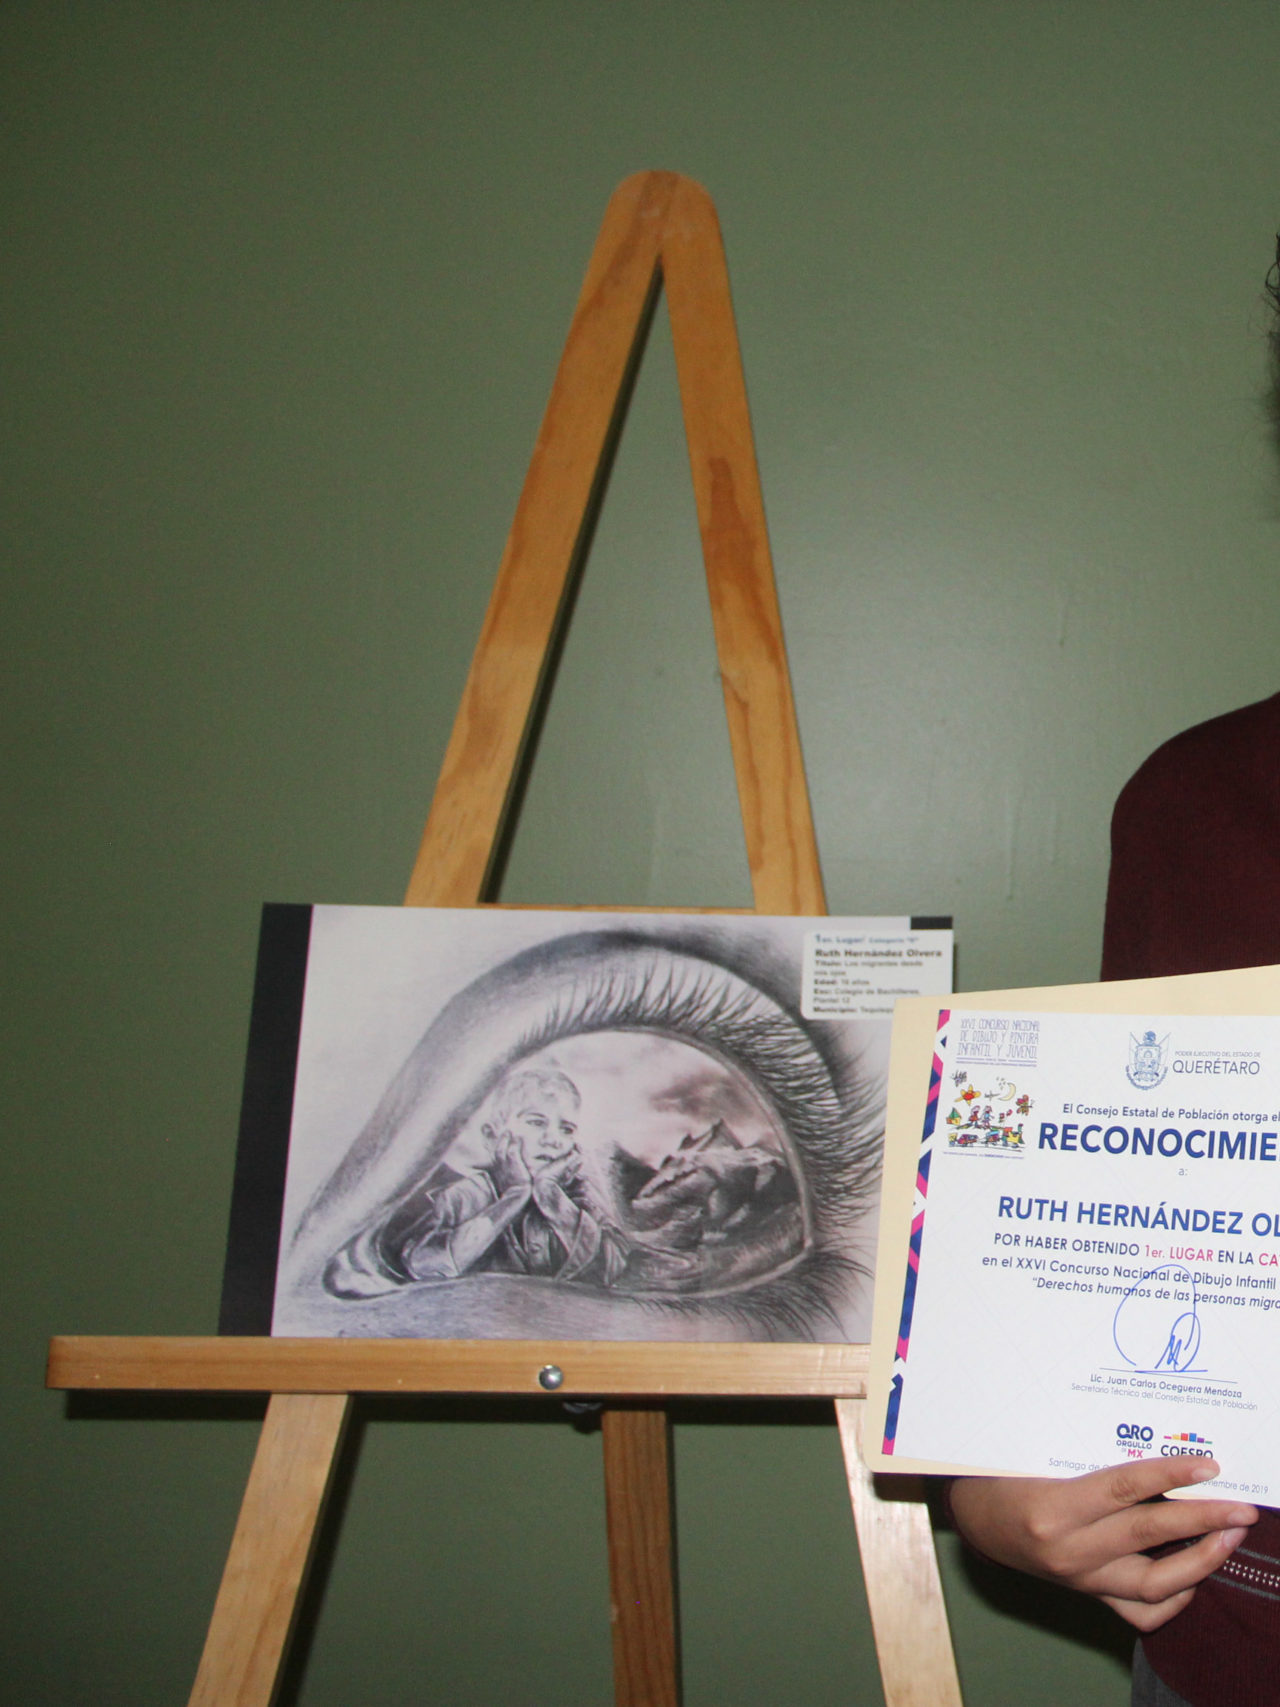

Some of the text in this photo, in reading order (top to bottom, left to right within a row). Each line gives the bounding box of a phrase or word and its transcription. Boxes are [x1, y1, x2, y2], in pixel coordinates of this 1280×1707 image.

[815, 949, 942, 957] Ruth Hernández Olvera
[960, 1018, 976, 1029] XXVI
[979, 1018, 1010, 1031] CONCURSO
[960, 1030, 1039, 1045] DE DIBUJO Y PINTURA
[957, 1042, 1038, 1059] INFANTIL Y JUVENIL
[1172, 1058, 1260, 1075] QUERÉTARO
[1063, 1103, 1073, 1114] El
[1076, 1104, 1119, 1118] Consejo
[1122, 1106, 1158, 1118] Estatal
[1161, 1108, 1175, 1119] de
[1178, 1108, 1229, 1121] Población
[1232, 1111, 1268, 1124] otorga
[1271, 1111, 1280, 1122] el
[1178, 1168, 1189, 1176] a:
[998, 1196, 1068, 1222] RUTH
[1077, 1201, 1243, 1235] HERNÁNDEZ
[994, 1232, 1021, 1247] POR
[1025, 1235, 1067, 1250] HABER
[1072, 1239, 1139, 1256] OBTENIDO
[1145, 1244, 1165, 1258] 1er.
[1170, 1246, 1213, 1262] LUGAR
[1218, 1250, 1234, 1263] EN
[1239, 1252, 1254, 1265] LA
[982, 1256, 997, 1267] en
[1001, 1256, 1013, 1268] el
[1016, 1257, 1046, 1271] XXVI
[1050, 1260, 1109, 1276] Concurso
[1113, 1265, 1170, 1281] Nacional
[1173, 1271, 1190, 1283] de
[1193, 1272, 1233, 1289] Dibujo
[1236, 1275, 1276, 1290] Infantil
[1096, 1282, 1151, 1298] humanos
[1155, 1288, 1171, 1300] de
[1173, 1289, 1190, 1301] las
[1193, 1293, 1246, 1306] personas
[1090, 1374, 1242, 1398] Lic. Juan Carlos Oceguera Mendoza
[1071, 1383, 1258, 1410] Secretario Técnico del Consejo Estatal de Población
[1116, 1423, 1154, 1442] QRO
[1116, 1440, 1152, 1449] ORGULLO
[1127, 1449, 1144, 1458] MX
[1049, 1458, 1086, 1471] Santiago
[1089, 1462, 1100, 1471] de
[1201, 1480, 1268, 1493] oviembre de 2019
